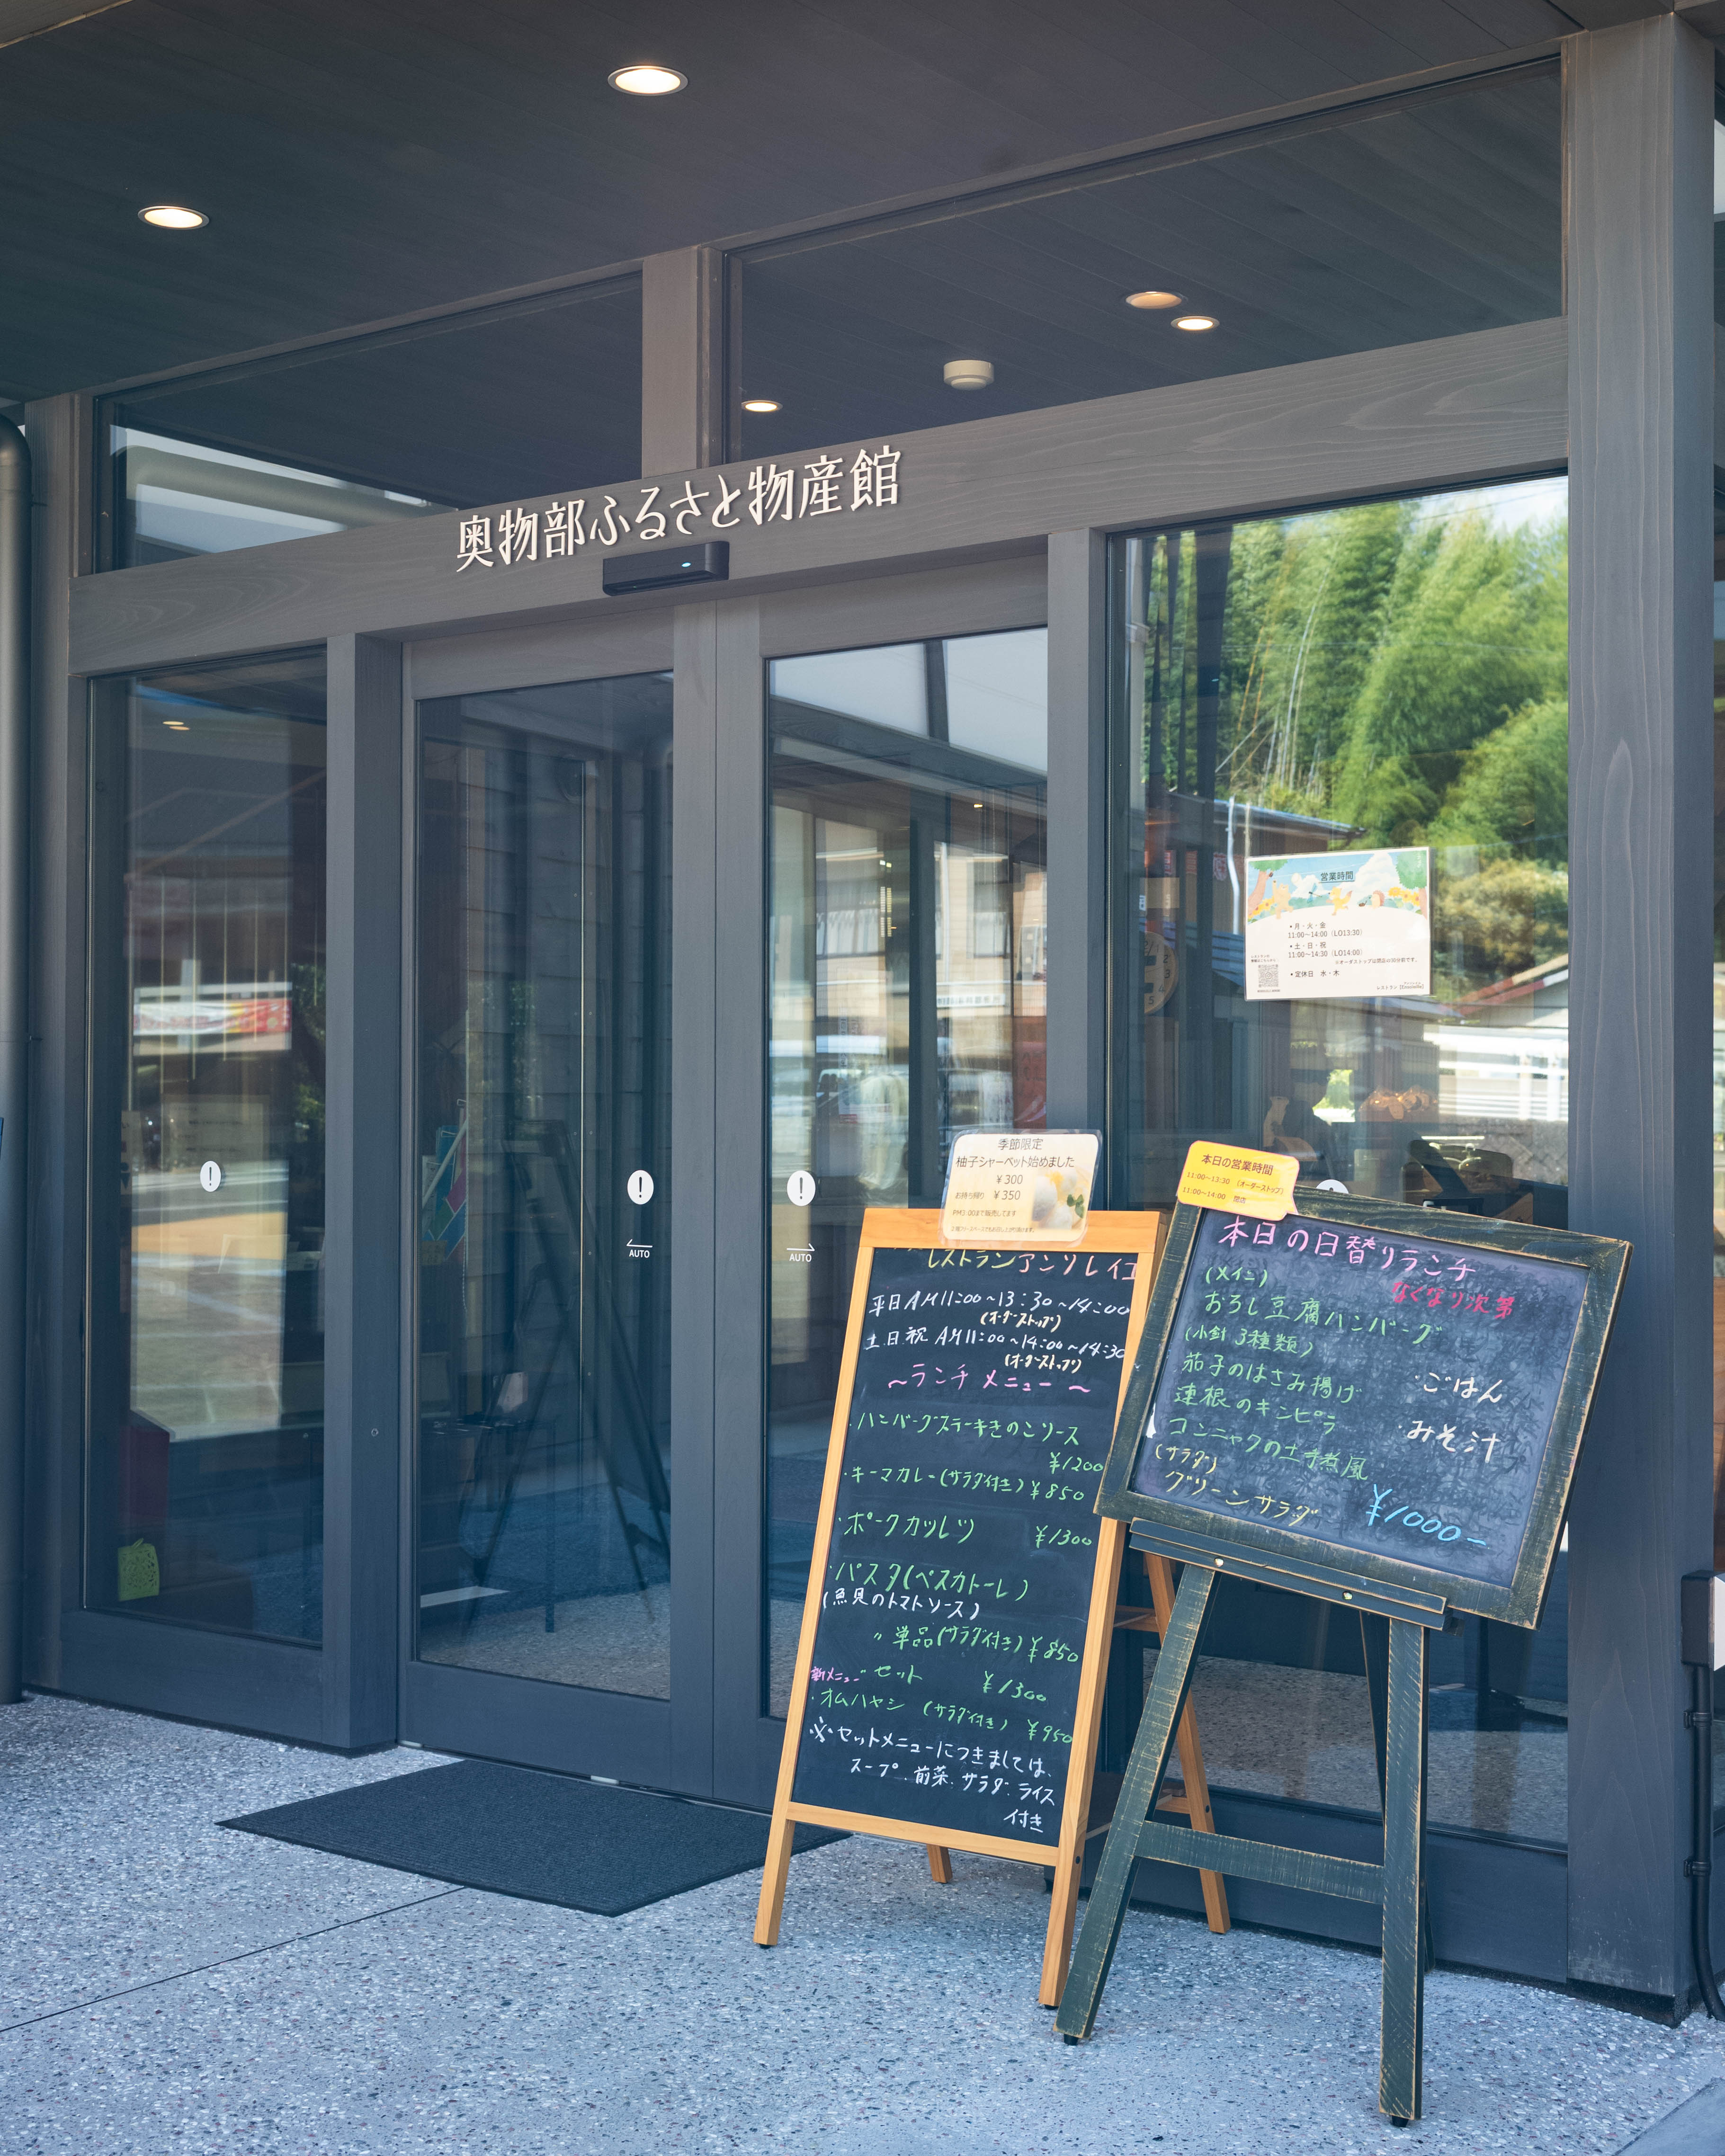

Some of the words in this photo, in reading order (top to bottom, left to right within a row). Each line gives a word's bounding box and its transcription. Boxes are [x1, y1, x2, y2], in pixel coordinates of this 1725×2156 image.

[456, 445, 901, 571] 奥物部ふるさと物産館
[1321, 871, 1354, 882] 営業時間
[998, 1138, 1043, 1150] 季節限定
[956, 1156, 1075, 1168] 柚子シャーベット始めました
[1201, 1154, 1274, 1176] 本日の営業時間
[1233, 1195, 1247, 1204] 閉店
[629, 1249, 650, 1258] AUTO
[789, 1253, 812, 1263] AUTO
[1182, 1353, 1363, 1403] 茄子のはさみ揚げ
[1049, 1452, 1104, 1474] ¥1200
[1036, 1525, 1092, 1549] ¥1300
[983, 1670, 1046, 1702] ¥1300
[1003, 1809, 1043, 1833] 付き
